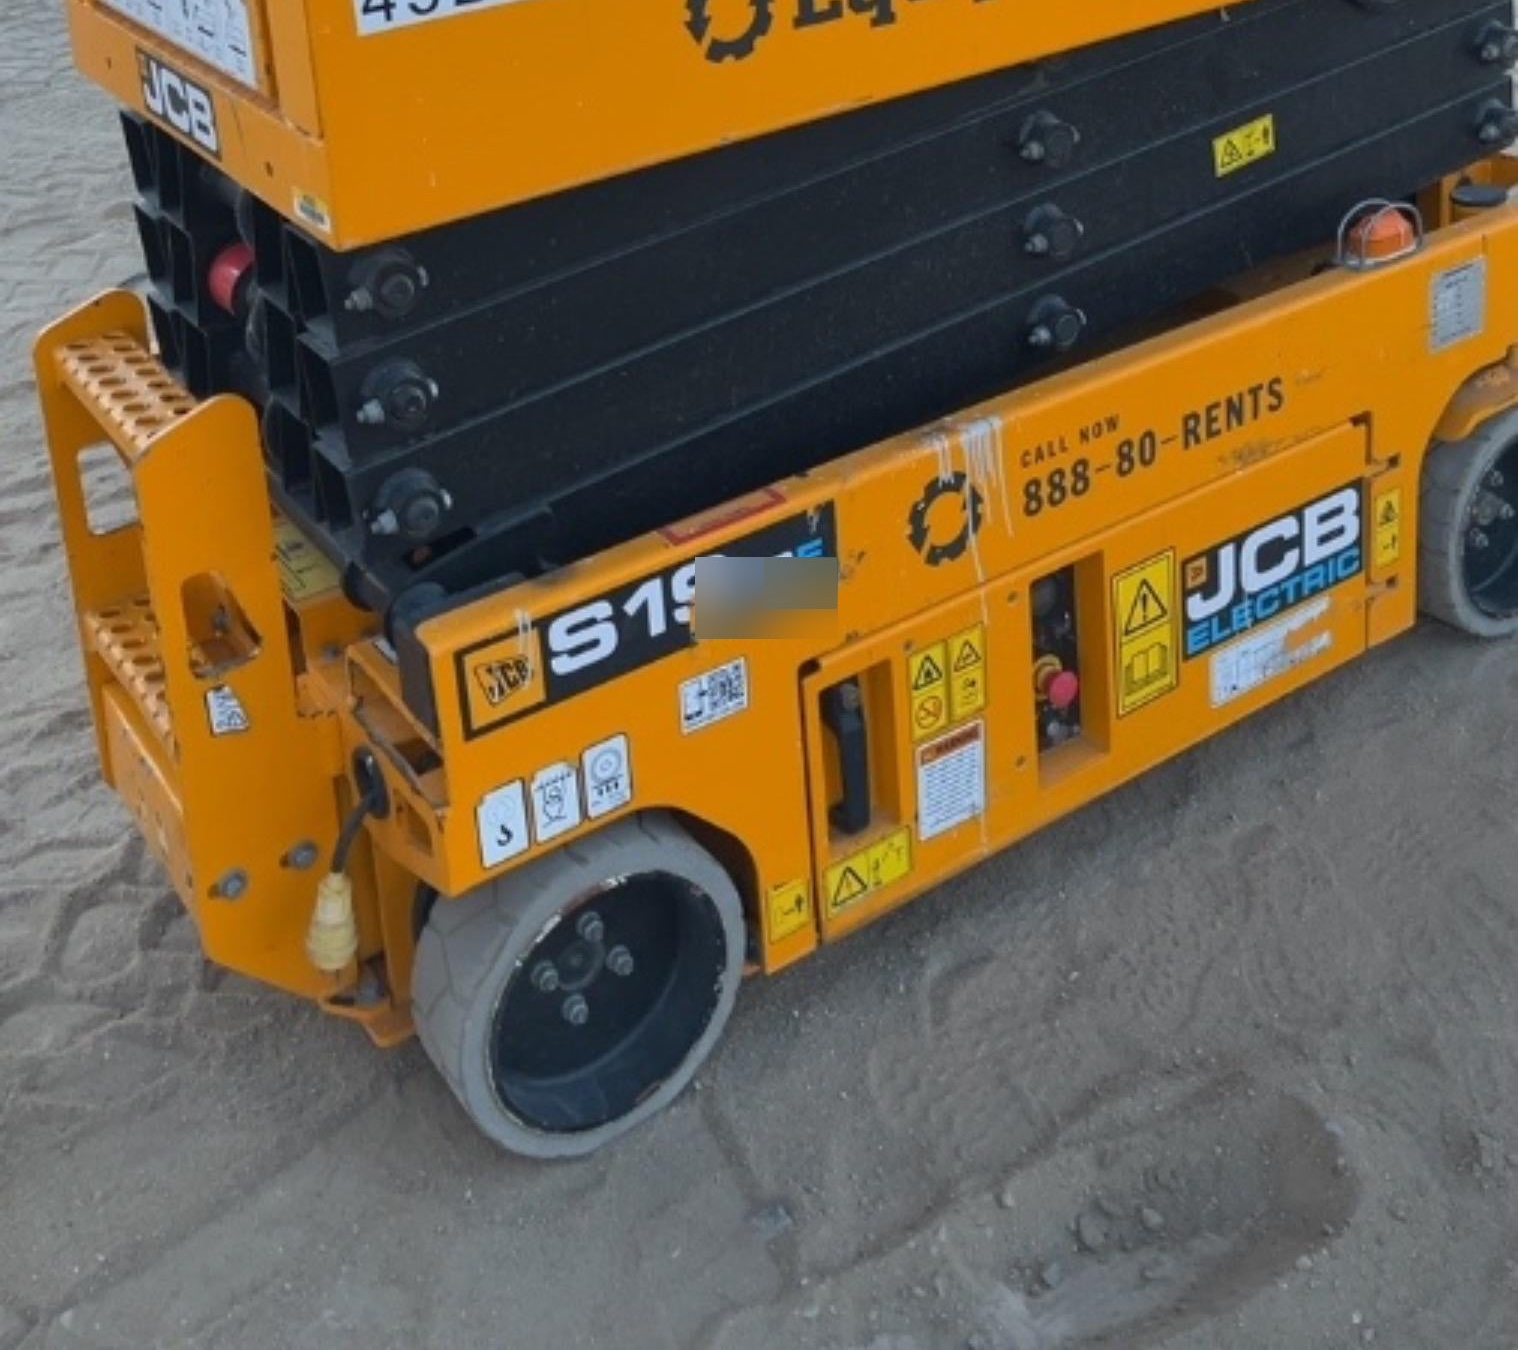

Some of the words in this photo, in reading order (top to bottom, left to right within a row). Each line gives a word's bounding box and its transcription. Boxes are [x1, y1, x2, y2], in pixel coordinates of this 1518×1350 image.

[142, 57, 218, 154] JCB
[1020, 435, 1069, 469] CALL
[1079, 414, 1120, 445] NOW
[1022, 376, 1285, 517] 888-80-RENTS
[1186, 488, 1360, 621] JCB
[1186, 546, 1361, 656] ELECTRIC
